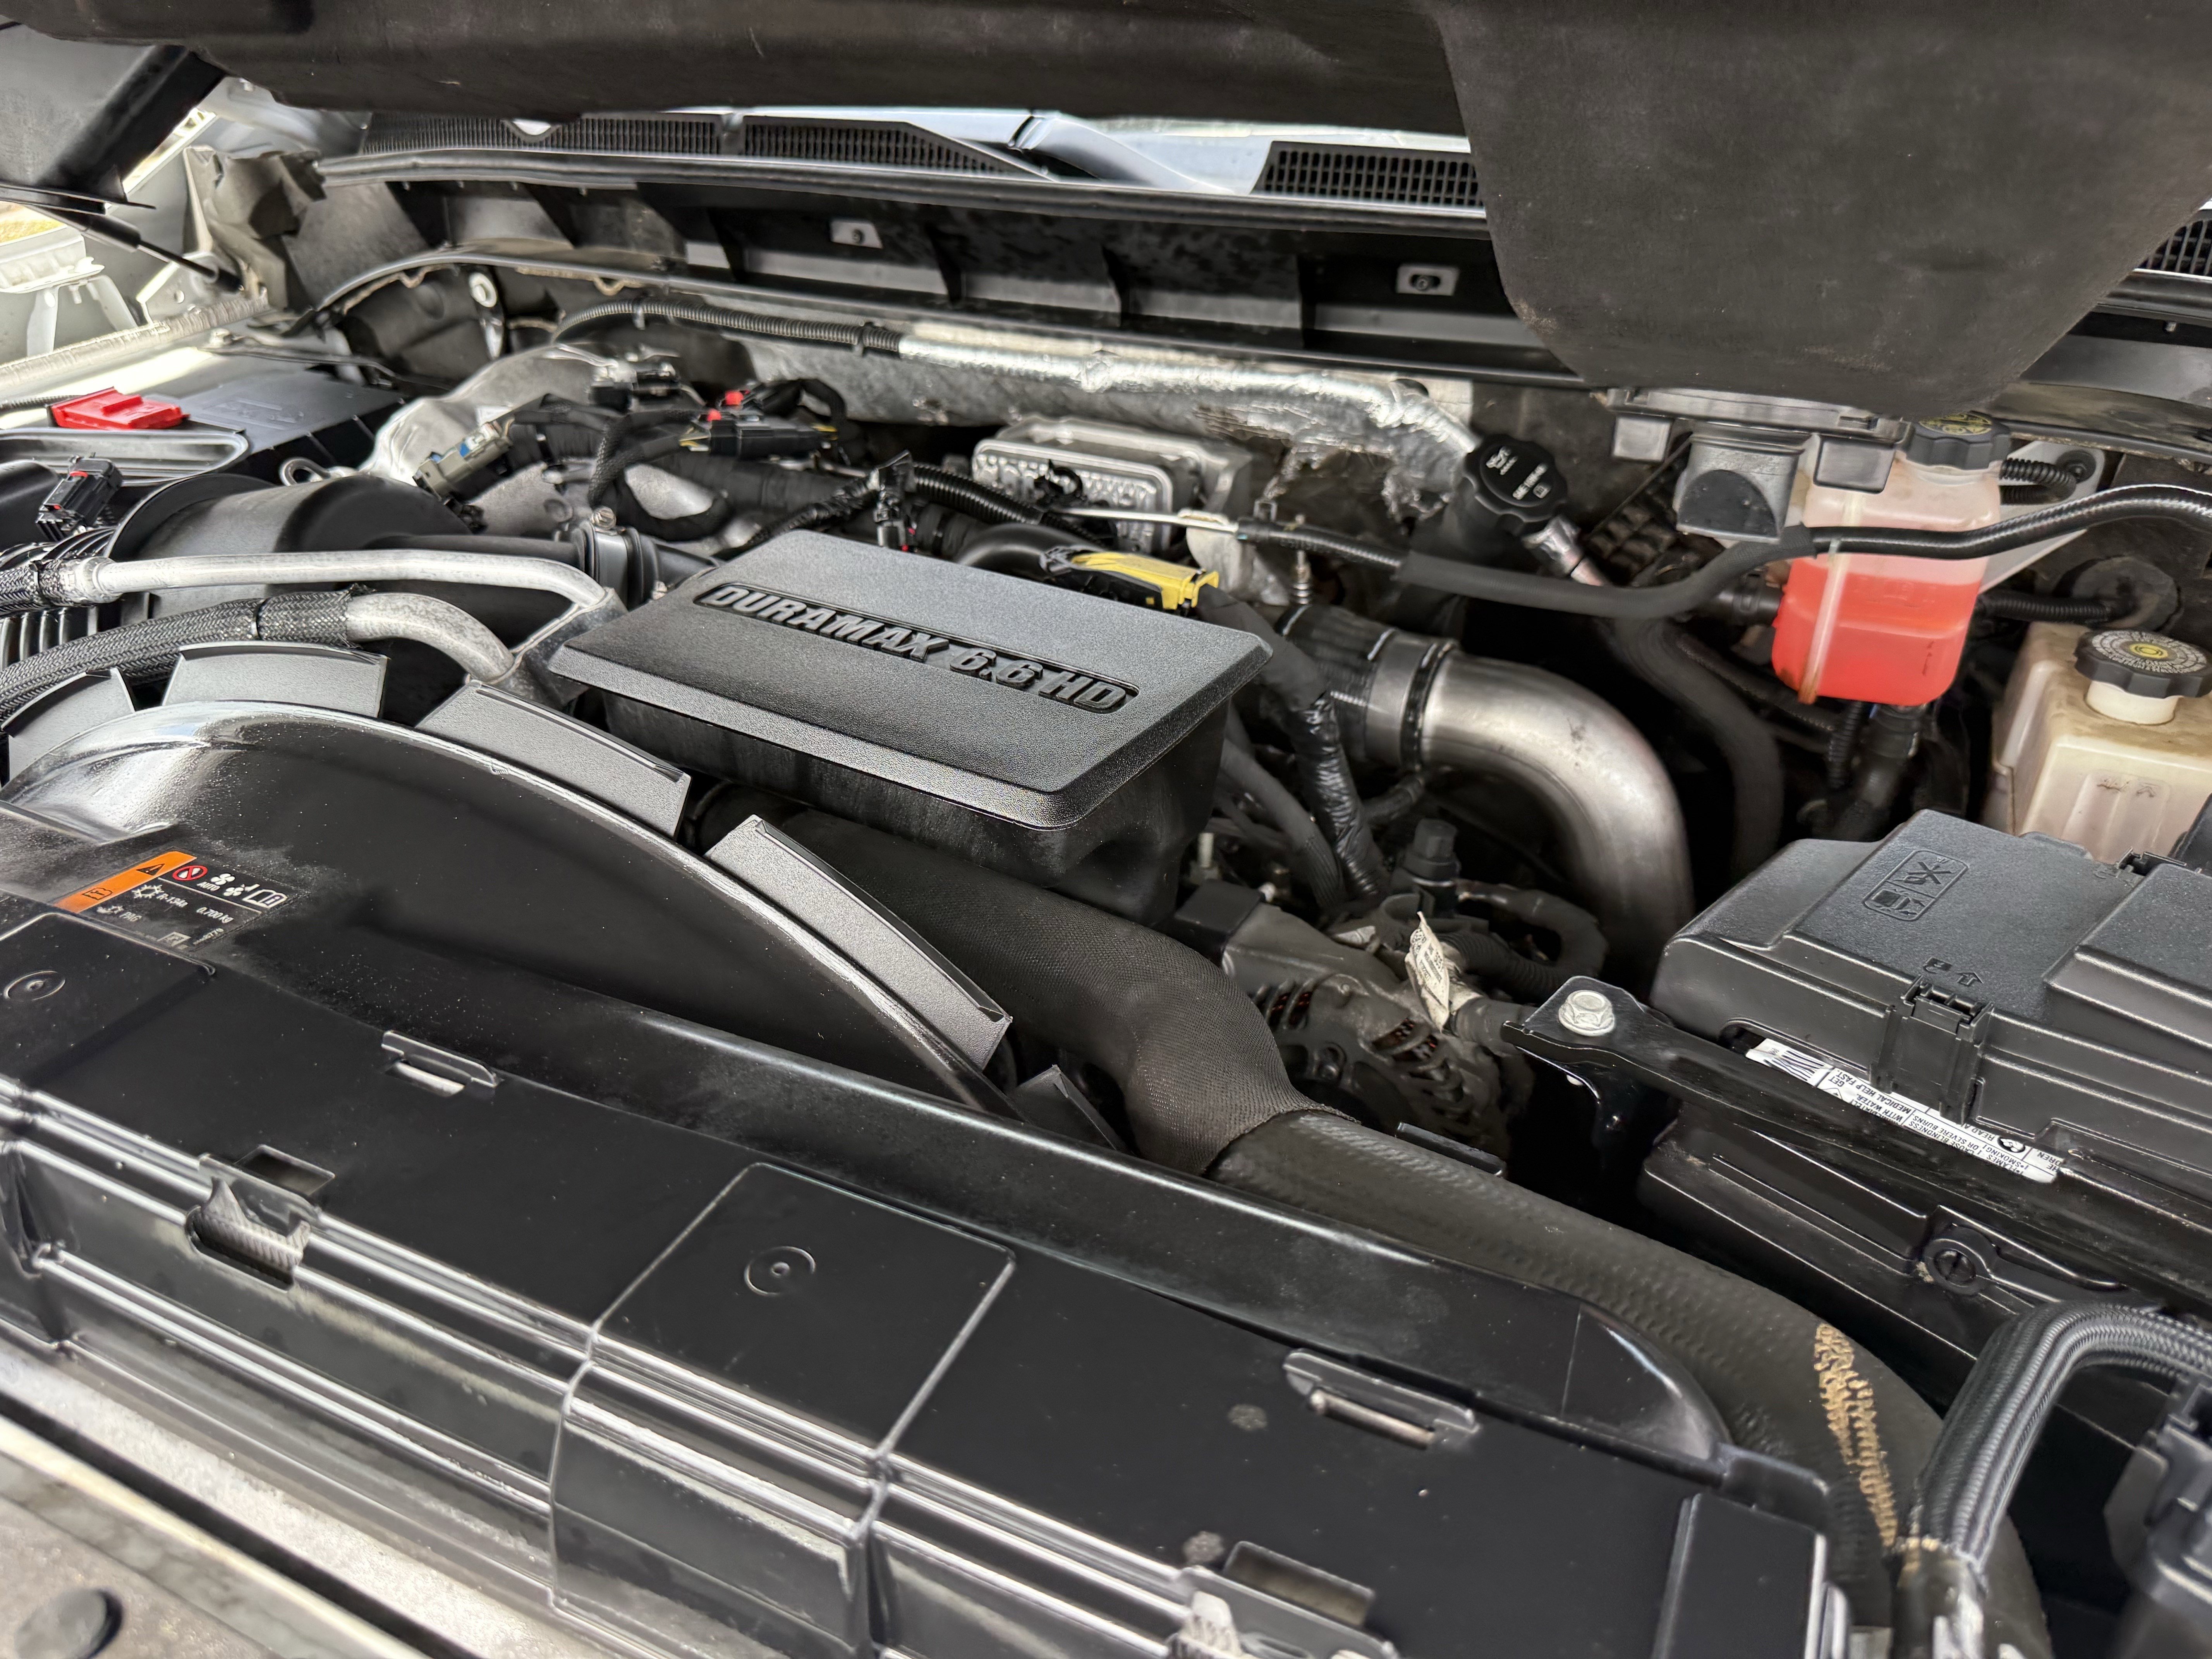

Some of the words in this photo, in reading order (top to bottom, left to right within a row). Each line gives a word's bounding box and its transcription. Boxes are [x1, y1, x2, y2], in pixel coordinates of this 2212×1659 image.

[699, 586, 950, 662] DURAMAX
[950, 647, 1043, 691] 6.6
[1039, 670, 1127, 711] HD
[197, 881, 221, 891] AUTO
[156, 893, 189, 908] R-134a
[118, 911, 143, 922] PAG
[1828, 1076, 1845, 1087] GET
[1835, 1070, 1856, 1085] FAST.
[1855, 1084, 1876, 1097] HELP
[1876, 1094, 1910, 1114] MEDICAL
[1882, 1108, 1903, 1122] WITH
[1912, 1114, 1938, 1130] BURNS.
[1908, 1121, 1949, 1143] BLINDNESS
[1937, 1127, 1967, 1145] SEVERE
[1971, 1127, 1995, 1141] READ
[1967, 1142, 1979, 1150] OR
[1985, 1146, 2021, 1167] SMOKING
